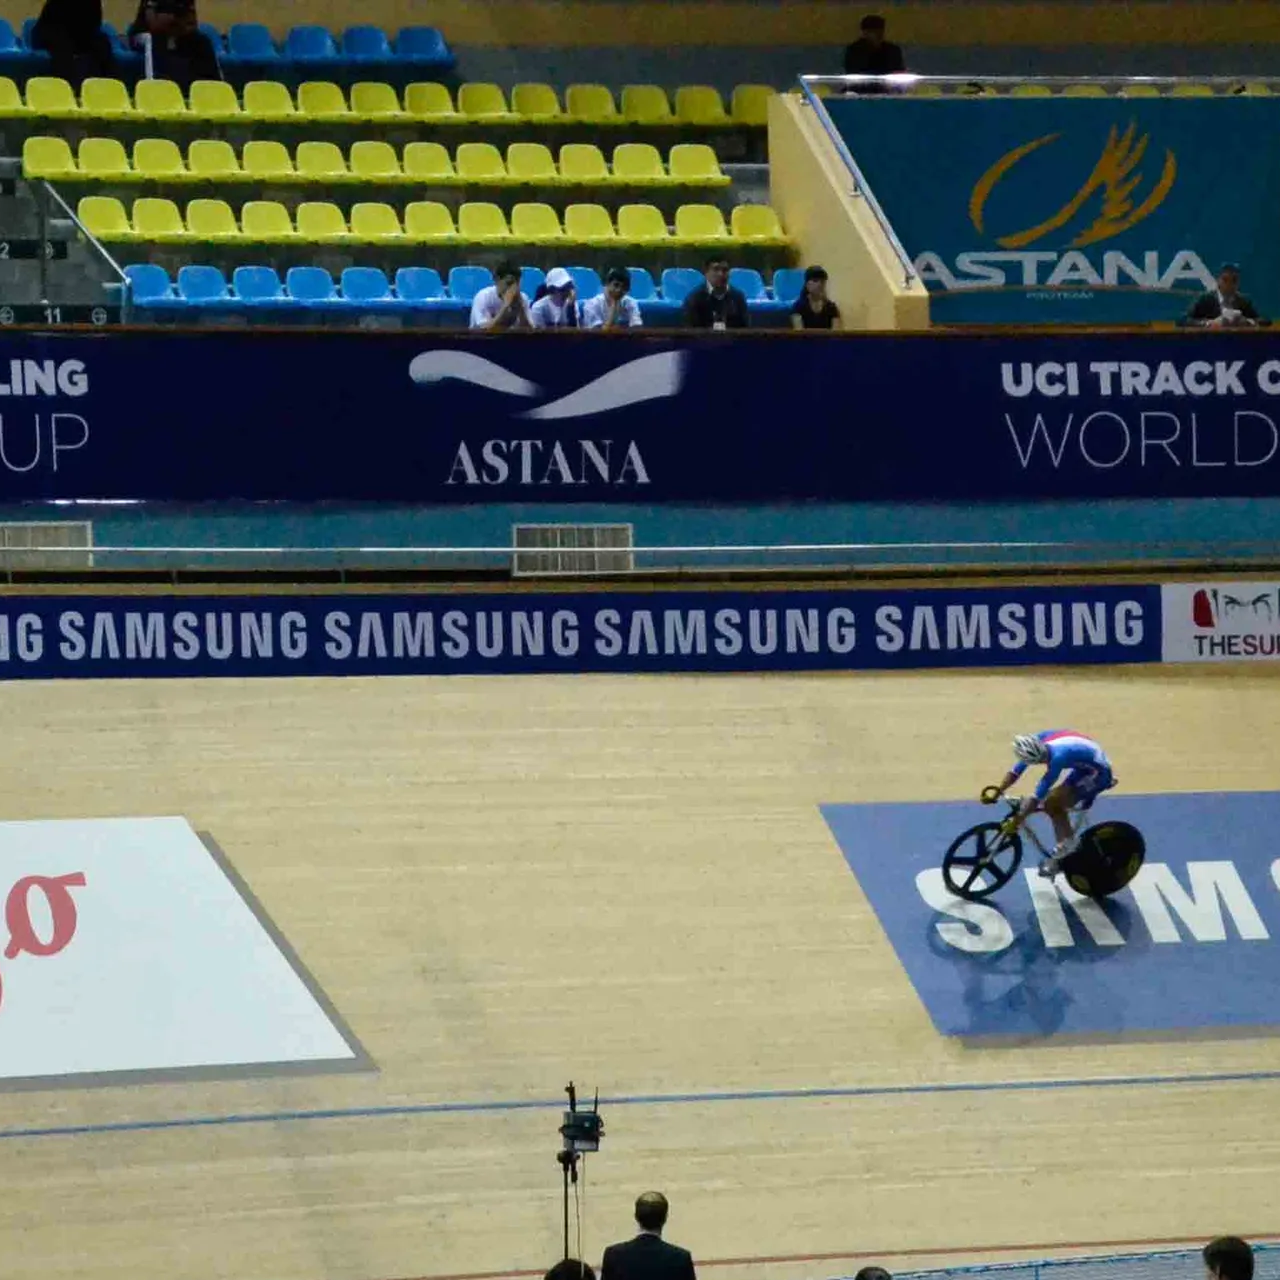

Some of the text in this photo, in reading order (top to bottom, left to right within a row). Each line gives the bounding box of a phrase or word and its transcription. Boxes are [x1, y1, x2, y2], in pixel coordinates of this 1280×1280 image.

[913, 250, 1217, 292] ASTANA
[44, 307, 62, 324] 11
[1002, 362, 1079, 397] UCI
[1089, 361, 1246, 396] TRACK
[1005, 411, 1278, 468] WORLD
[444, 439, 651, 485] ASTANA
[59, 611, 307, 659] SAMSUNG
[325, 611, 580, 659] SAMSUNG
[595, 608, 856, 656] SAMSUNG
[875, 602, 1144, 651] SAMSUNG
